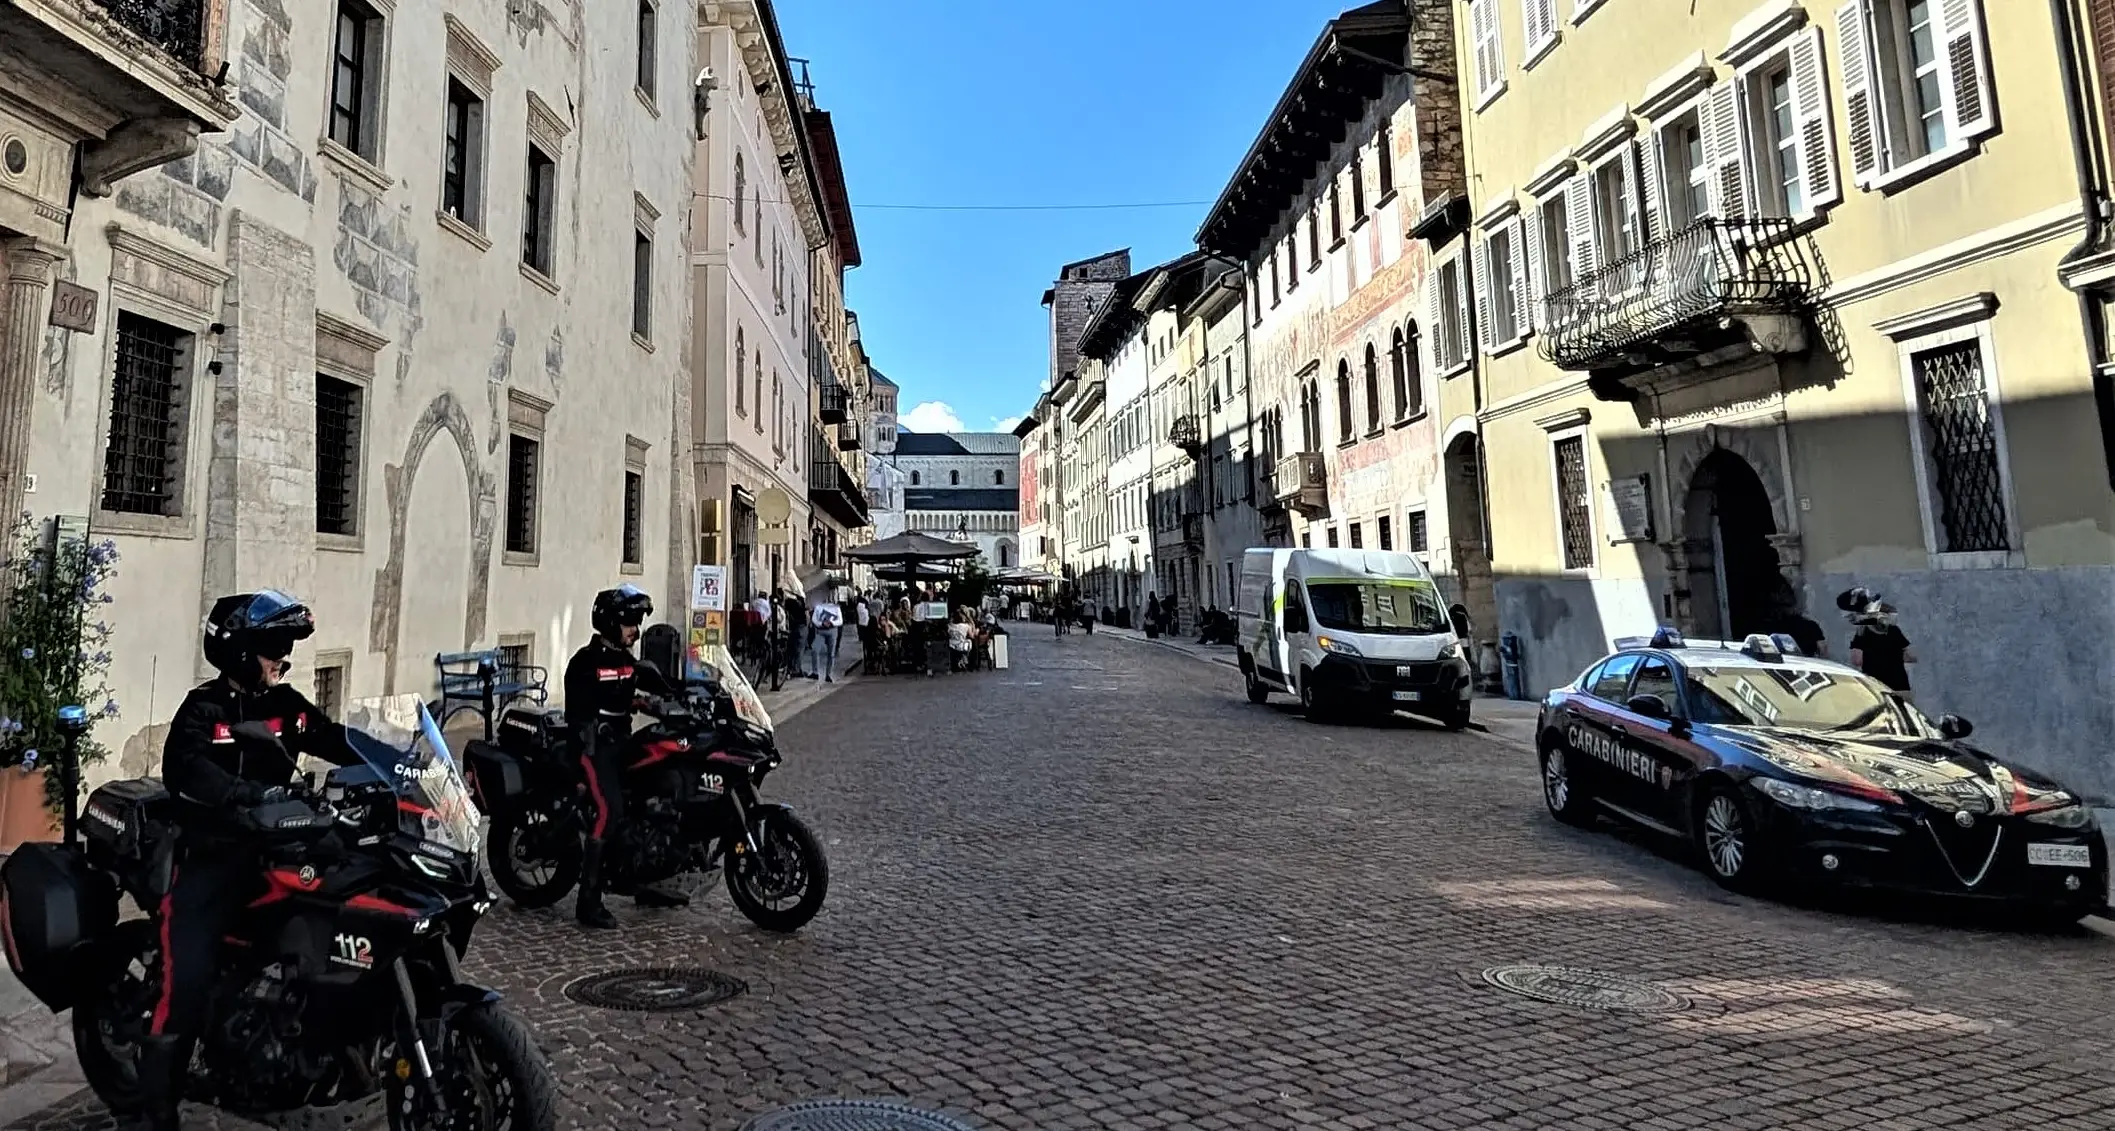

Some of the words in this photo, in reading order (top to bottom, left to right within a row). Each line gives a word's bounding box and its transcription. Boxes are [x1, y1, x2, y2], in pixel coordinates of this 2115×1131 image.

[1568, 725, 1656, 784] CARABINIERI
[701, 772, 724, 790] 112
[334, 932, 374, 963] 112
